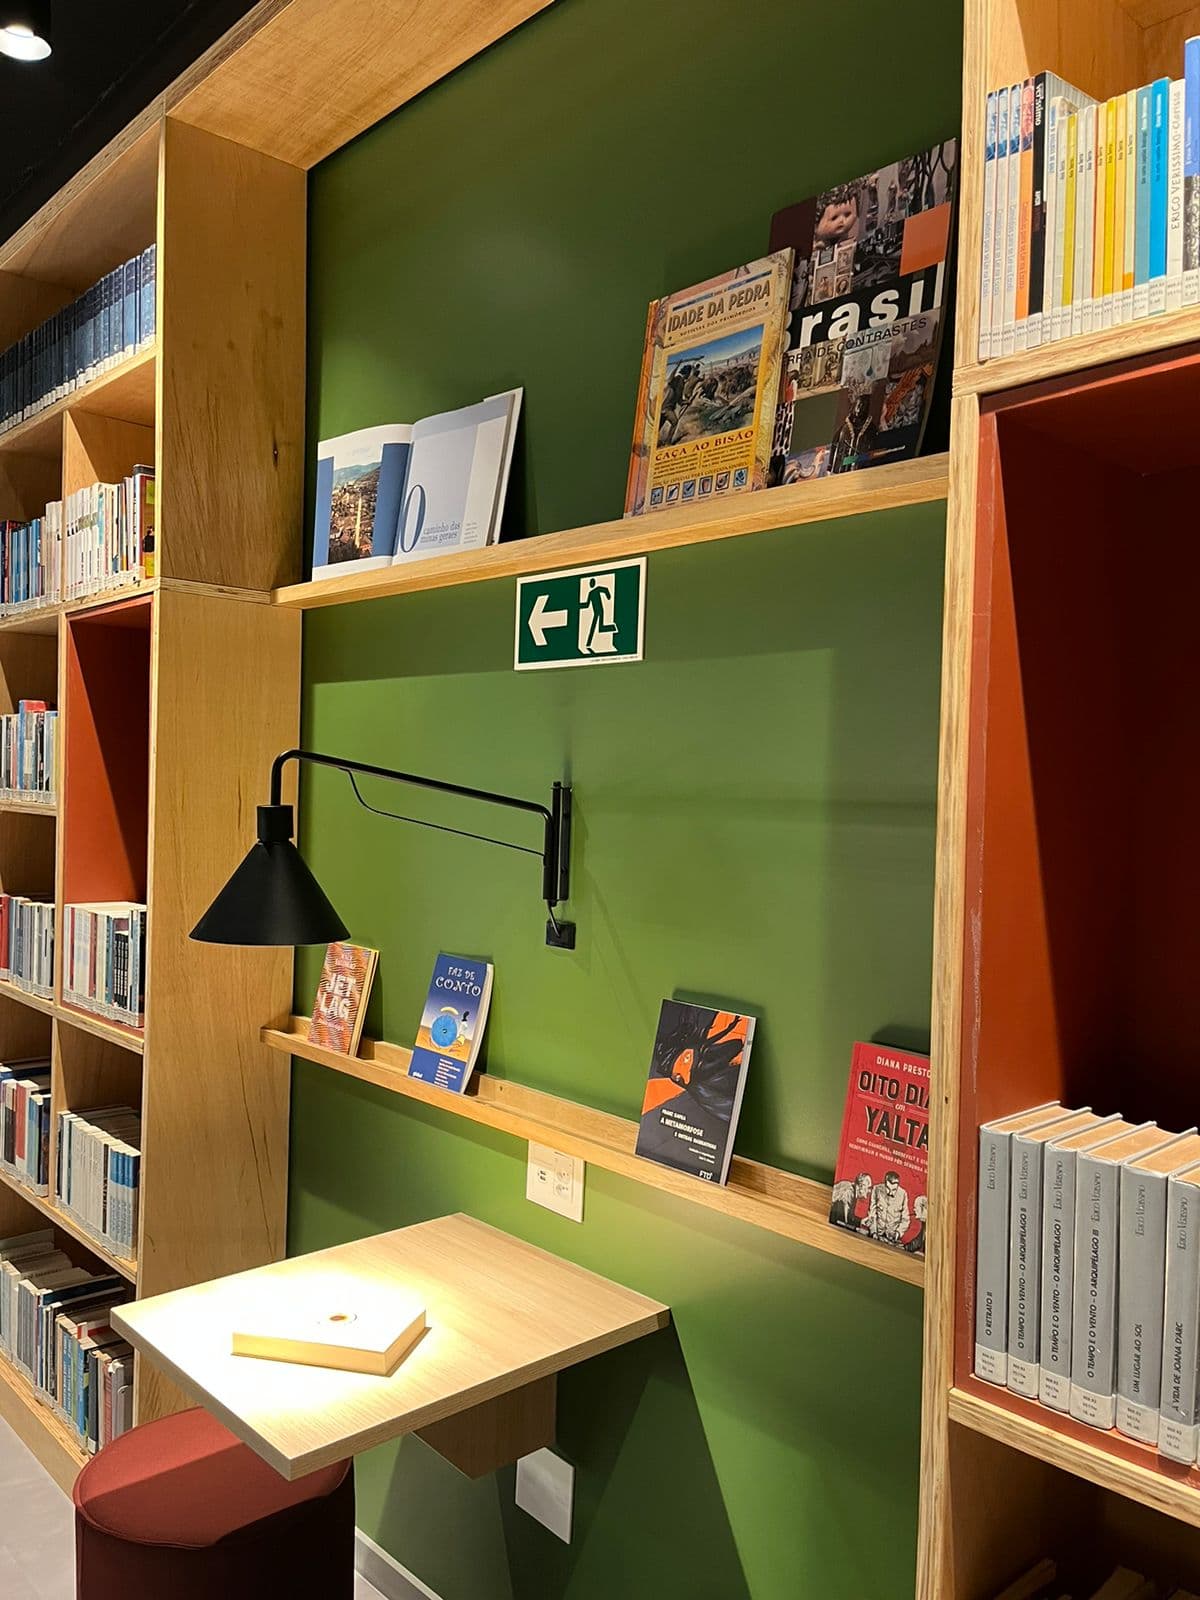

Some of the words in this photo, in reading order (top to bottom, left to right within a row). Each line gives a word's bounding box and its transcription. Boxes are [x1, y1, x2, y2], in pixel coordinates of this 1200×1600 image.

[1171, 196, 1180, 230] ERICO
[668, 305, 704, 333] IDADE
[707, 297, 724, 319] DA
[728, 280, 770, 311] PEDRA
[784, 262, 945, 352] rasil
[817, 344, 833, 358] DE
[836, 317, 927, 352] CONTRASTES
[656, 448, 687, 461] CAÇA
[692, 442, 710, 451] AO
[714, 430, 754, 446] BISÃO
[448, 966, 462, 978] FAZ
[465, 970, 475, 981] DE
[436, 976, 481, 996] CONTO
[876, 1056, 900, 1070] DIANA
[902, 1063, 931, 1078] PRESTO
[858, 1070, 900, 1100] OITO
[665, 1118, 704, 1136] METAMORFOSE
[865, 1105, 928, 1152] YALTA
[1089, 1304, 1097, 1328] VENTO
[1175, 1322, 1183, 1344] D'ARC
[1134, 1339, 1142, 1352] AO
[1174, 1346, 1182, 1374] JOANA
[1133, 1380, 1140, 1393] UM
[1173, 1374, 1181, 1384] DE
